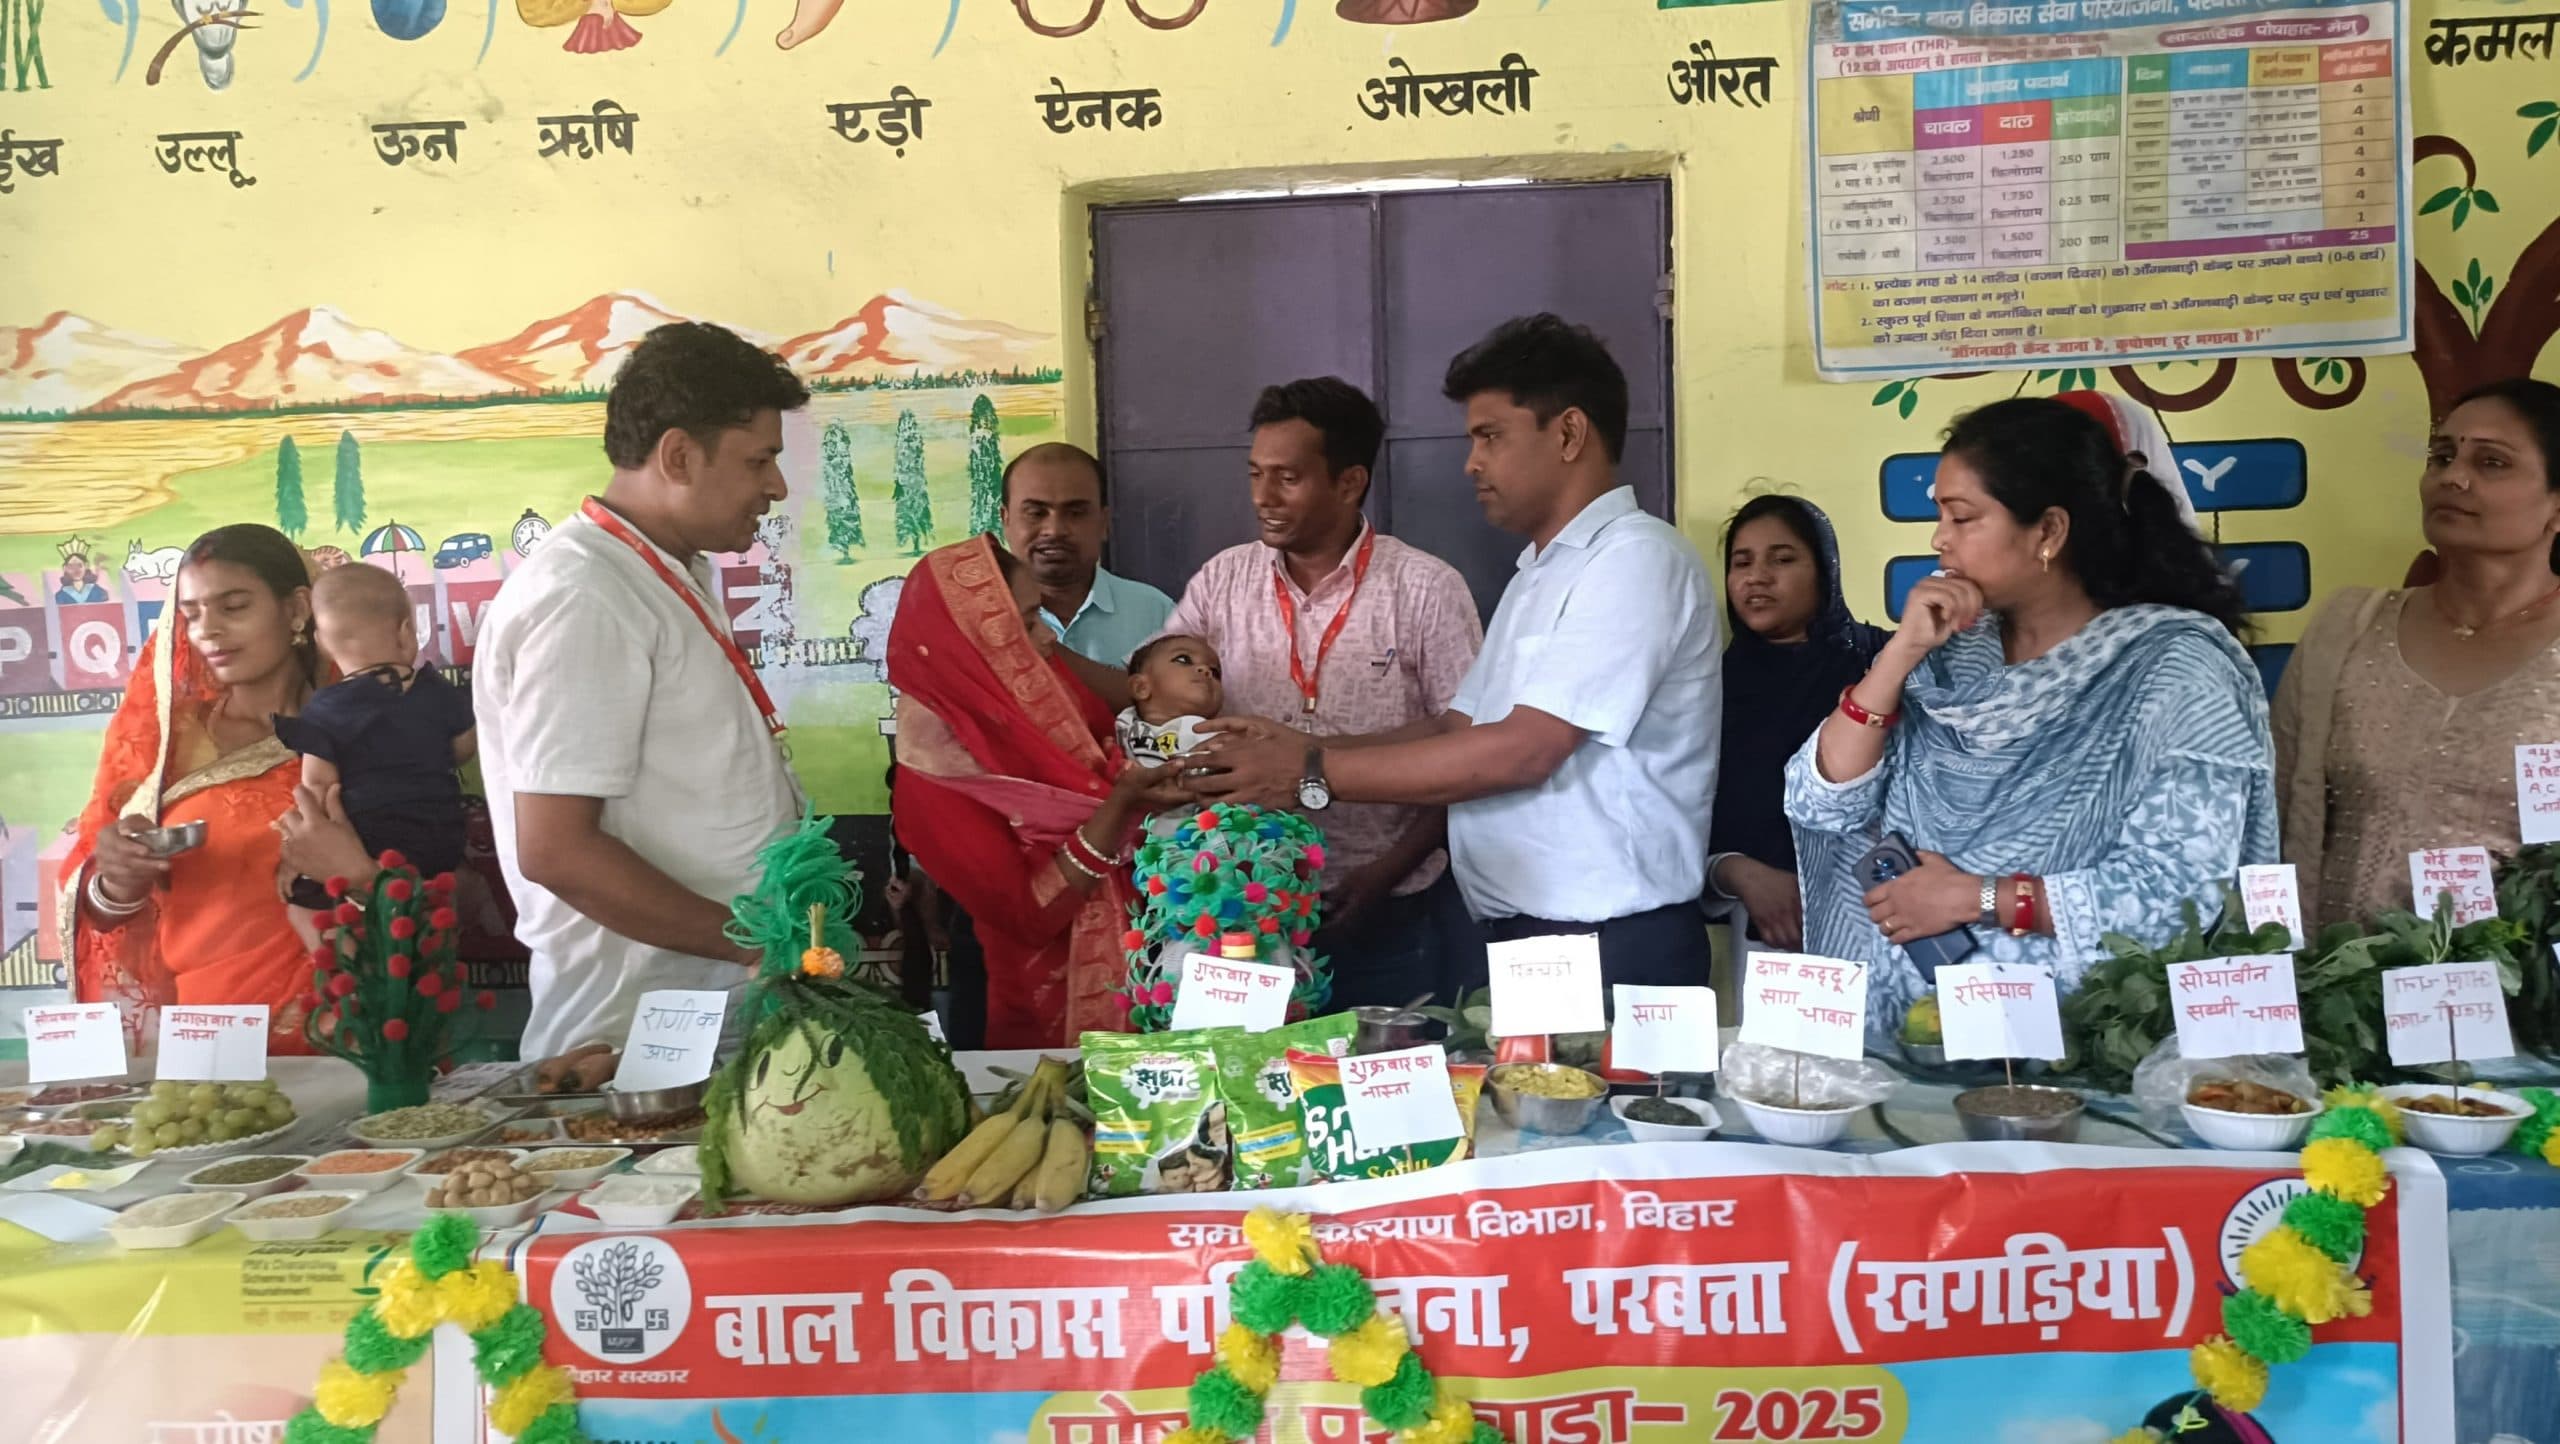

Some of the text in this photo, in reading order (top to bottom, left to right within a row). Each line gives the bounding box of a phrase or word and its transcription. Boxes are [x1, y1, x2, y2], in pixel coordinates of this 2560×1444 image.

[1969, 1, 2032, 26] विकास
[2424, 13, 2560, 67] कमल
[2353, 84, 2364, 93] 4
[154, 131, 256, 189] उल्लू
[372, 120, 466, 166] ऊन
[537, 100, 639, 159] ऋषि
[826, 86, 931, 158] एड़ी
[1035, 76, 1163, 133] ऐनक
[1357, 53, 1539, 119] ओखली
[1667, 40, 1779, 109] औरत
[2354, 105, 2364, 115] 4
[1924, 119, 1971, 135] चावल
[2000, 114, 2035, 129] दाल
[2354, 127, 2364, 136] 4
[2355, 146, 2365, 156] 4
[2355, 167, 2365, 177] 4
[2355, 190, 2365, 199] 4
[2350, 230, 2370, 241] 25
[1963, 274, 1977, 284] 14
[70, 621, 120, 679] Q
[1756, 960, 1791, 976] दाल
[1760, 988, 1801, 1005] साग
[1632, 1004, 1678, 1027] साग
[1135, 1068, 1184, 1095] सुधा
[1266, 1072, 1292, 1097] सु
[1467, 1200, 1607, 1239] विभाग,
[1621, 1191, 1738, 1232] बिहार
[705, 1290, 864, 1367] बाल
[885, 1269, 1128, 1364] विकास
[1564, 1259, 1789, 1336] परबत्ता
[1827, 1227, 2195, 1354] (खगड़िया)
[618, 1369, 690, 1385] सरकार
[1711, 1385, 1884, 1441] 2025
